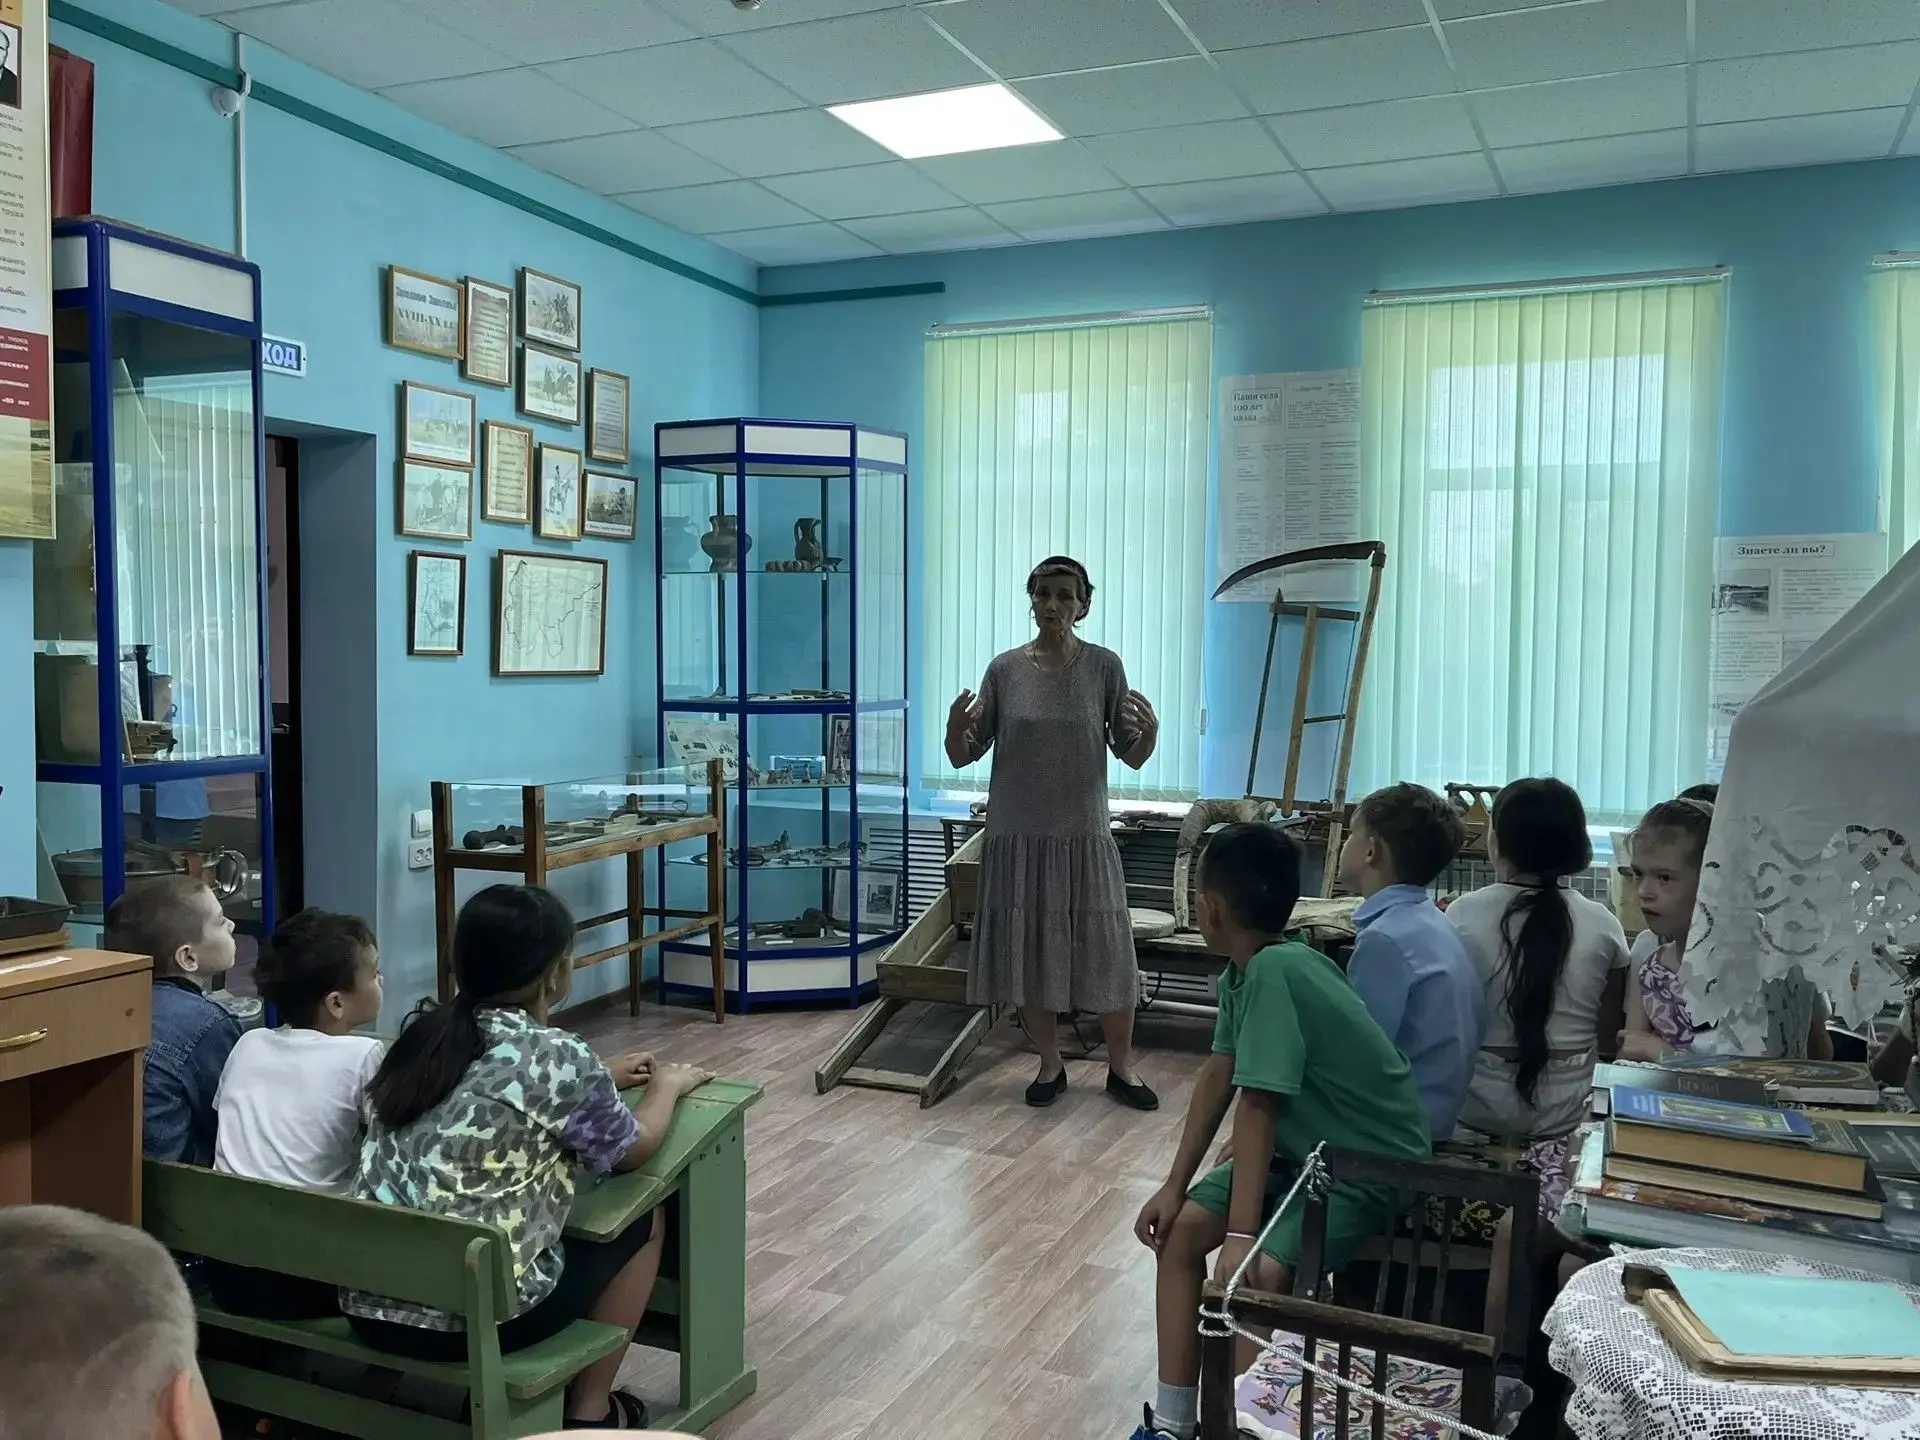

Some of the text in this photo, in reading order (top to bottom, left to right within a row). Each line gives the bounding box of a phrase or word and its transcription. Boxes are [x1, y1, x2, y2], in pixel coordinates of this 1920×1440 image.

[1737, 544, 1826, 556] Знаете ли вы?
